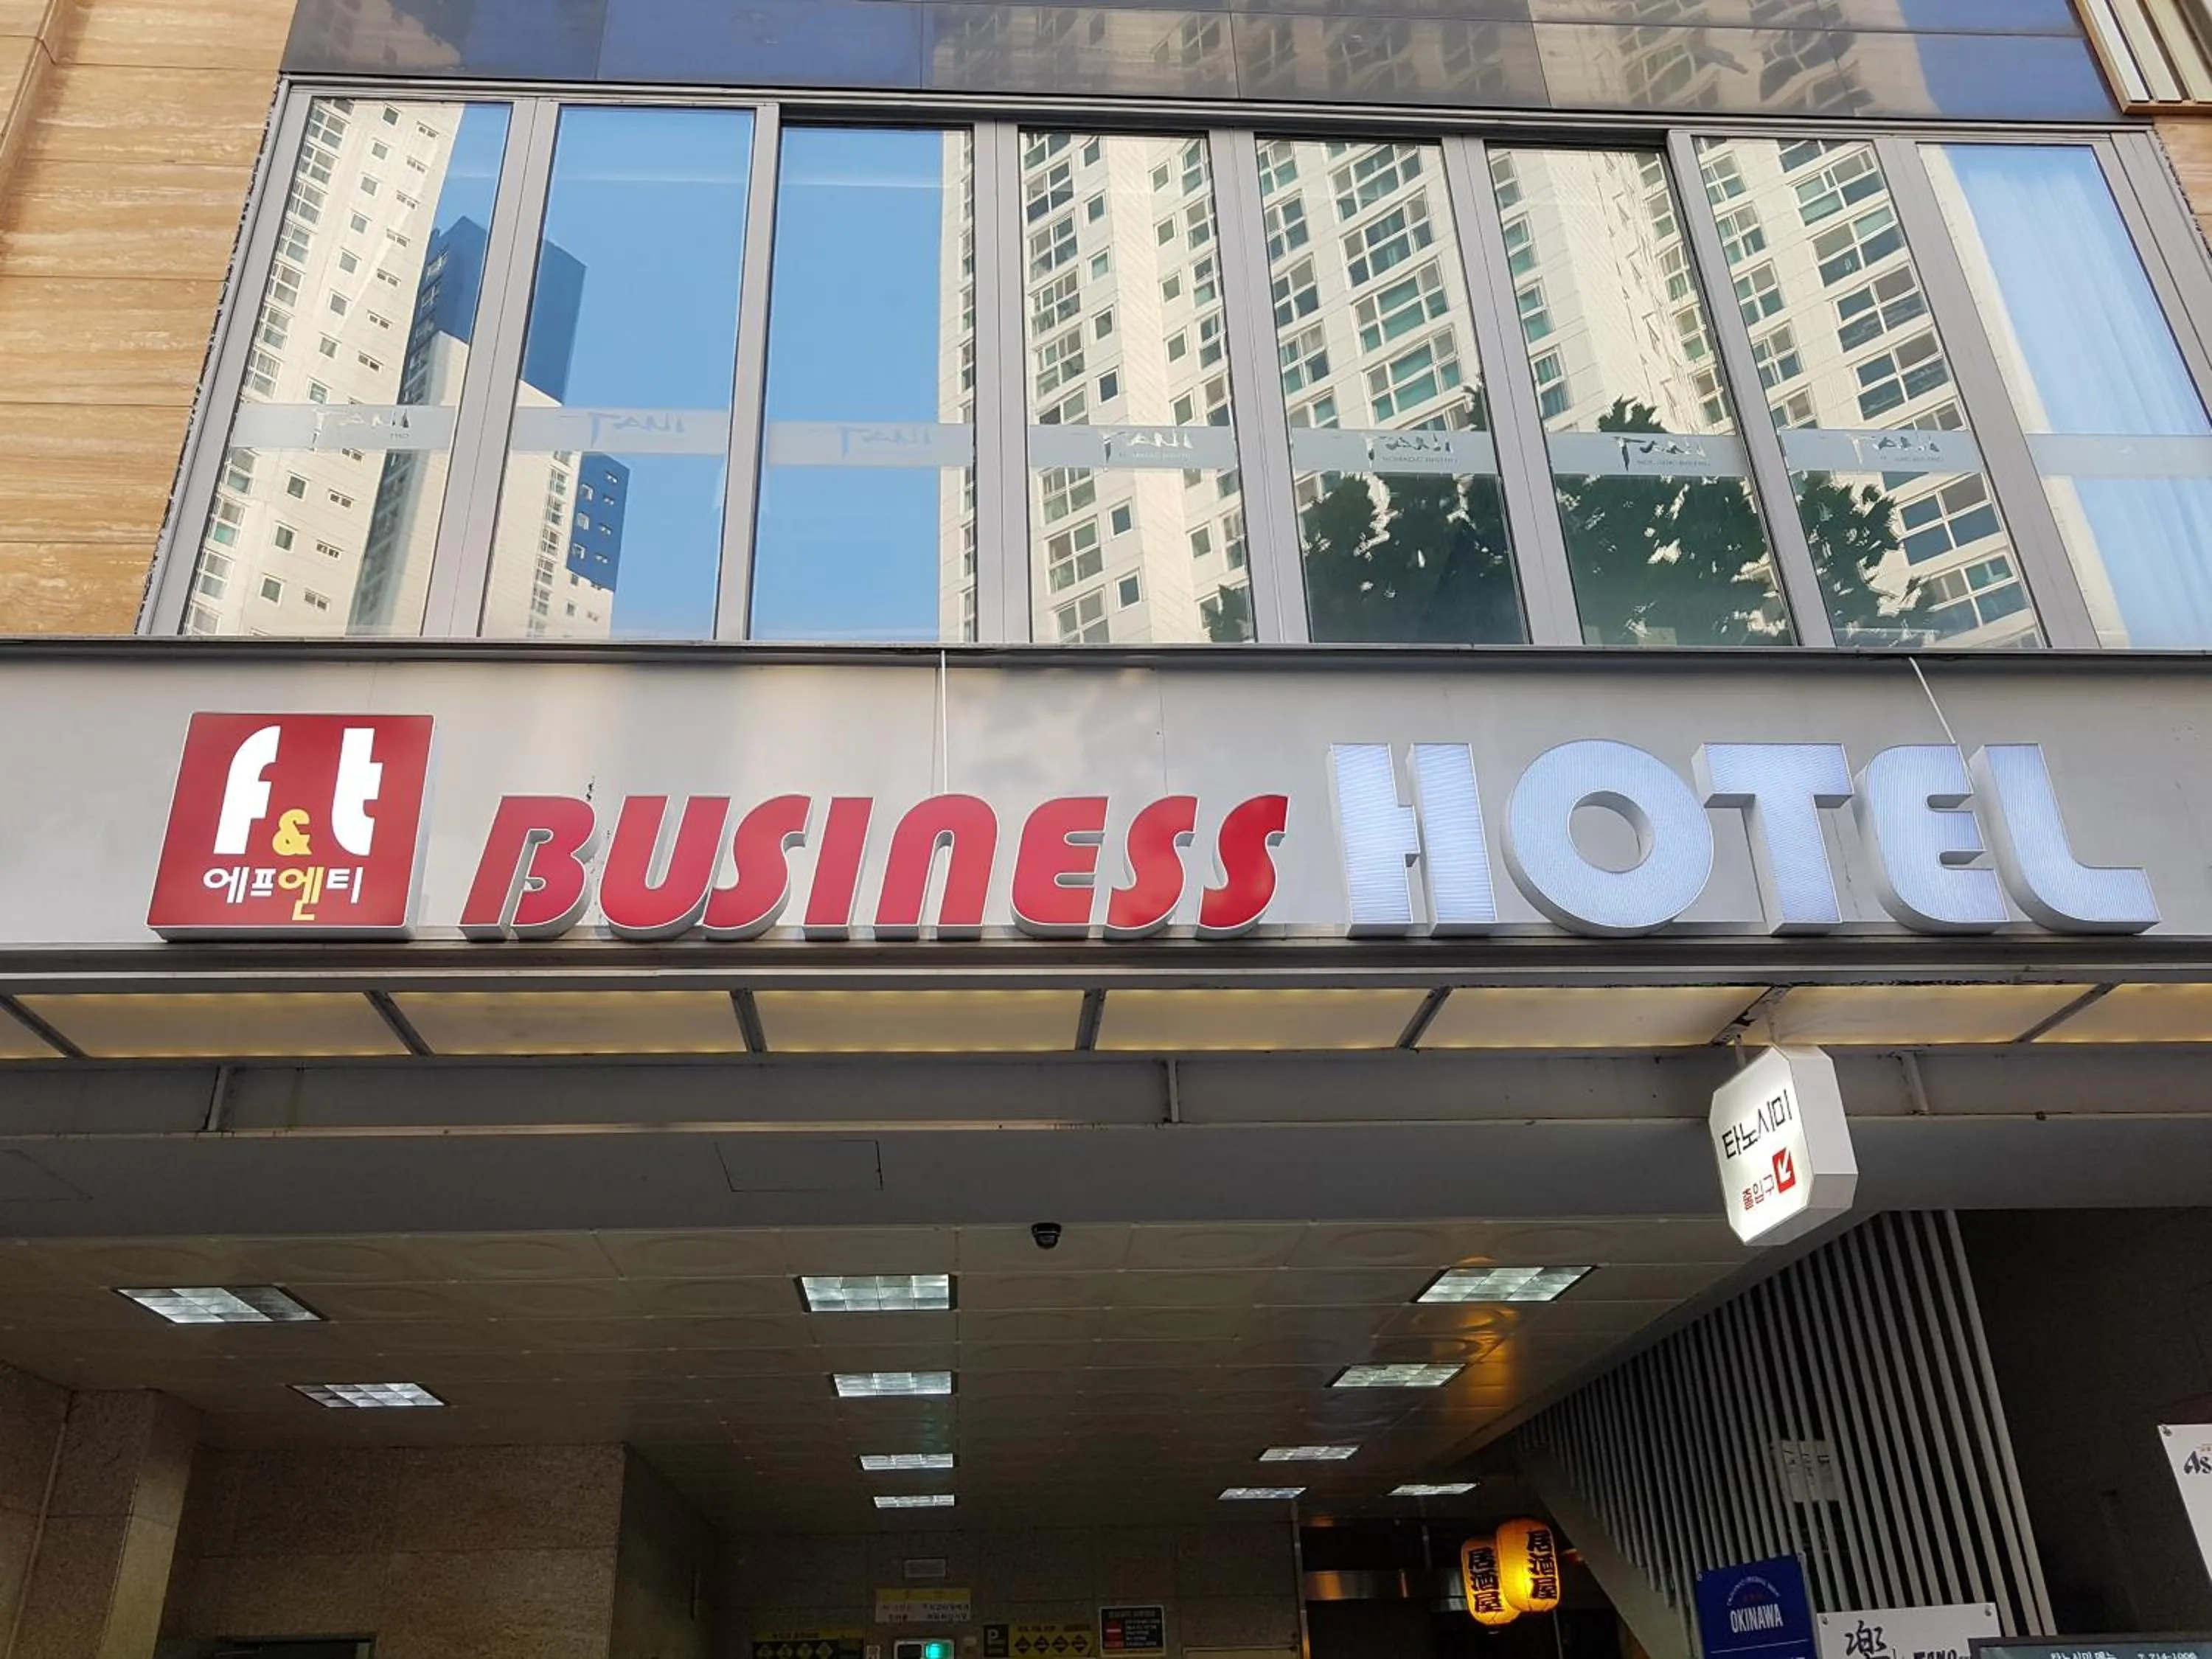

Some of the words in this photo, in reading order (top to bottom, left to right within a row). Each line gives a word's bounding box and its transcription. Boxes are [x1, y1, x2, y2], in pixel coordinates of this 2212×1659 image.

[459, 794, 1288, 939] BUSINESS
[1329, 738, 2162, 936] HOTEL
[203, 866, 365, 921] 에프엔티
[1722, 1089, 1792, 1160] 타노시미
[1468, 1546, 1505, 1613] 居酒屋
[1526, 1529, 1558, 1599] 居酒屋
[1730, 1603, 1784, 1633] OKINAWA
